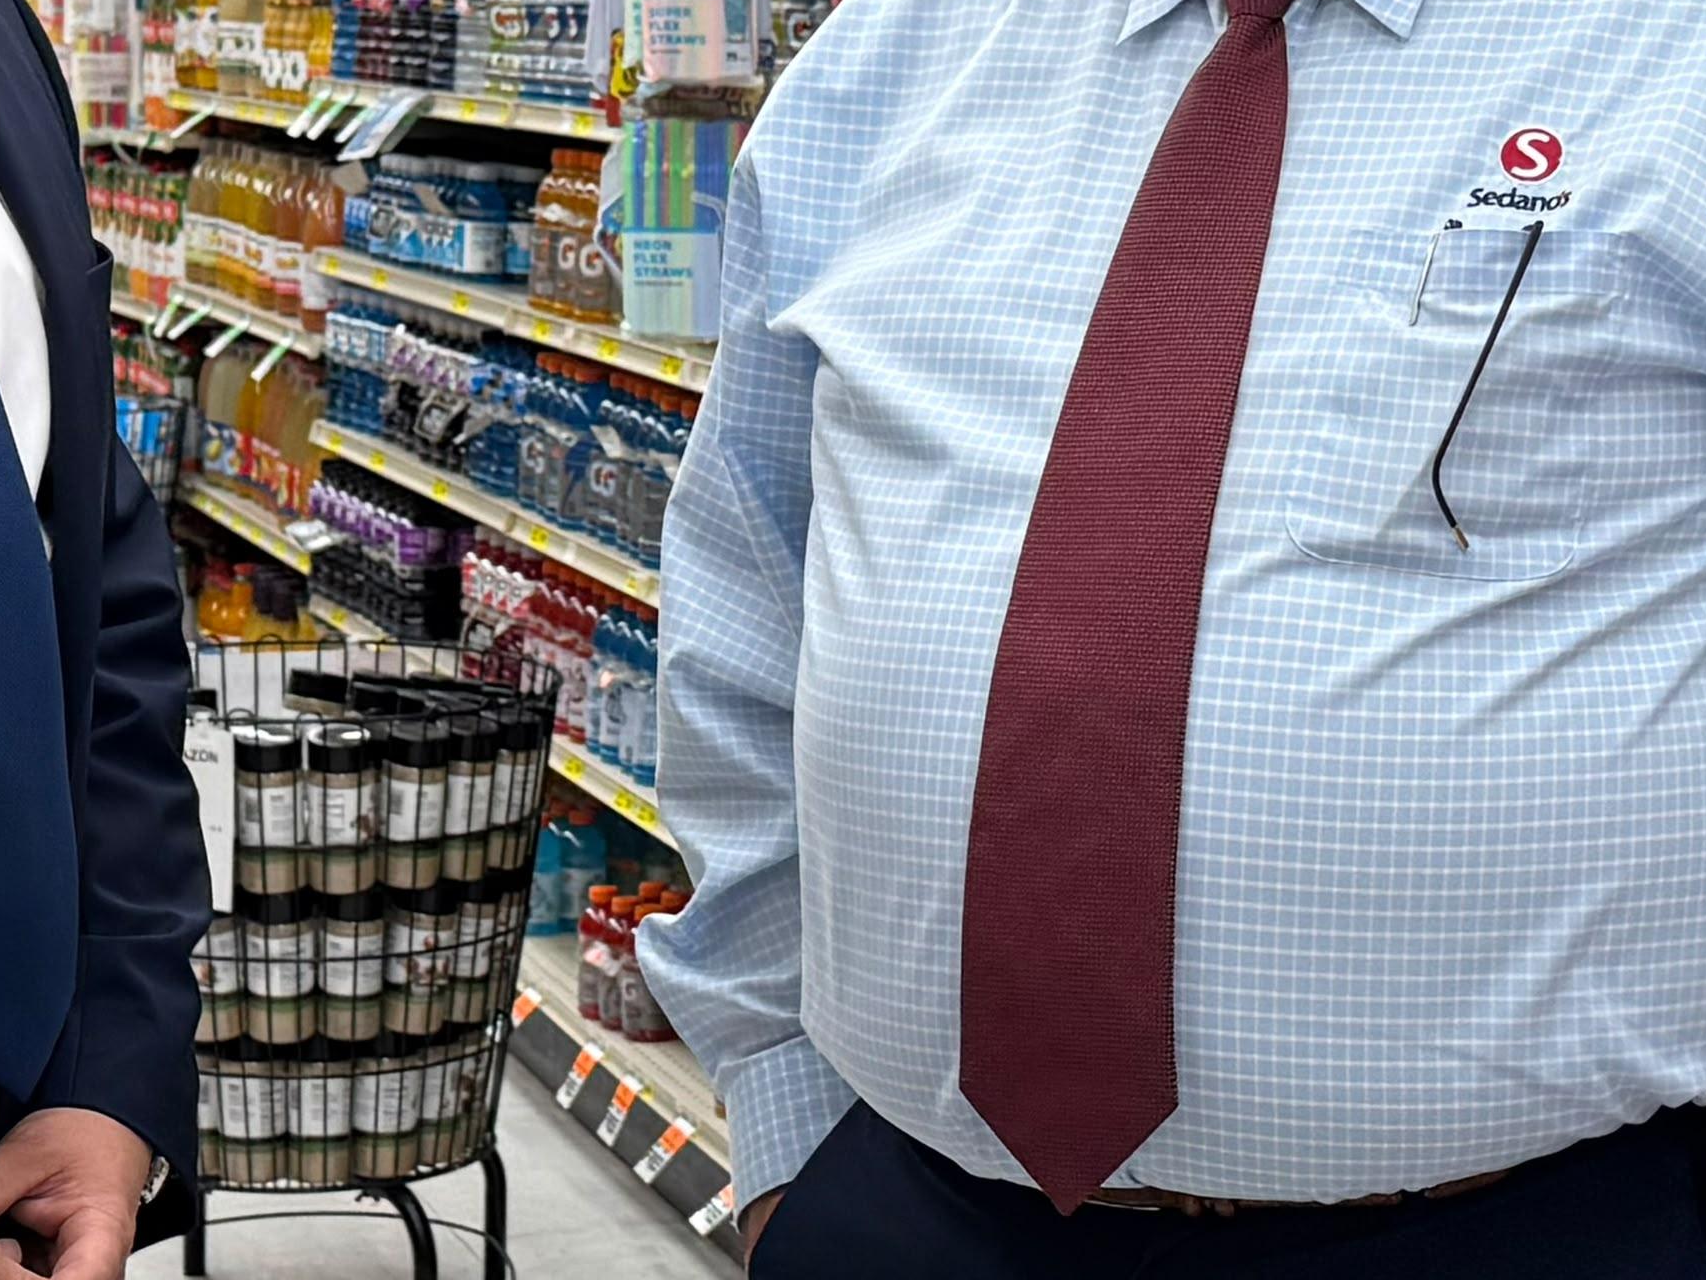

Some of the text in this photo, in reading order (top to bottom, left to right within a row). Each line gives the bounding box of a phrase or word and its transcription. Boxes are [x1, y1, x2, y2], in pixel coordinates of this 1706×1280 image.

[648, 5, 692, 20] SUPER
[648, 19, 682, 34] FLEX
[648, 32, 708, 47] STRAWS
[1509, 130, 1551, 178] S
[633, 239, 672, 254] NEON
[633, 252, 669, 267] FLEX
[634, 266, 694, 280] STRAWS
